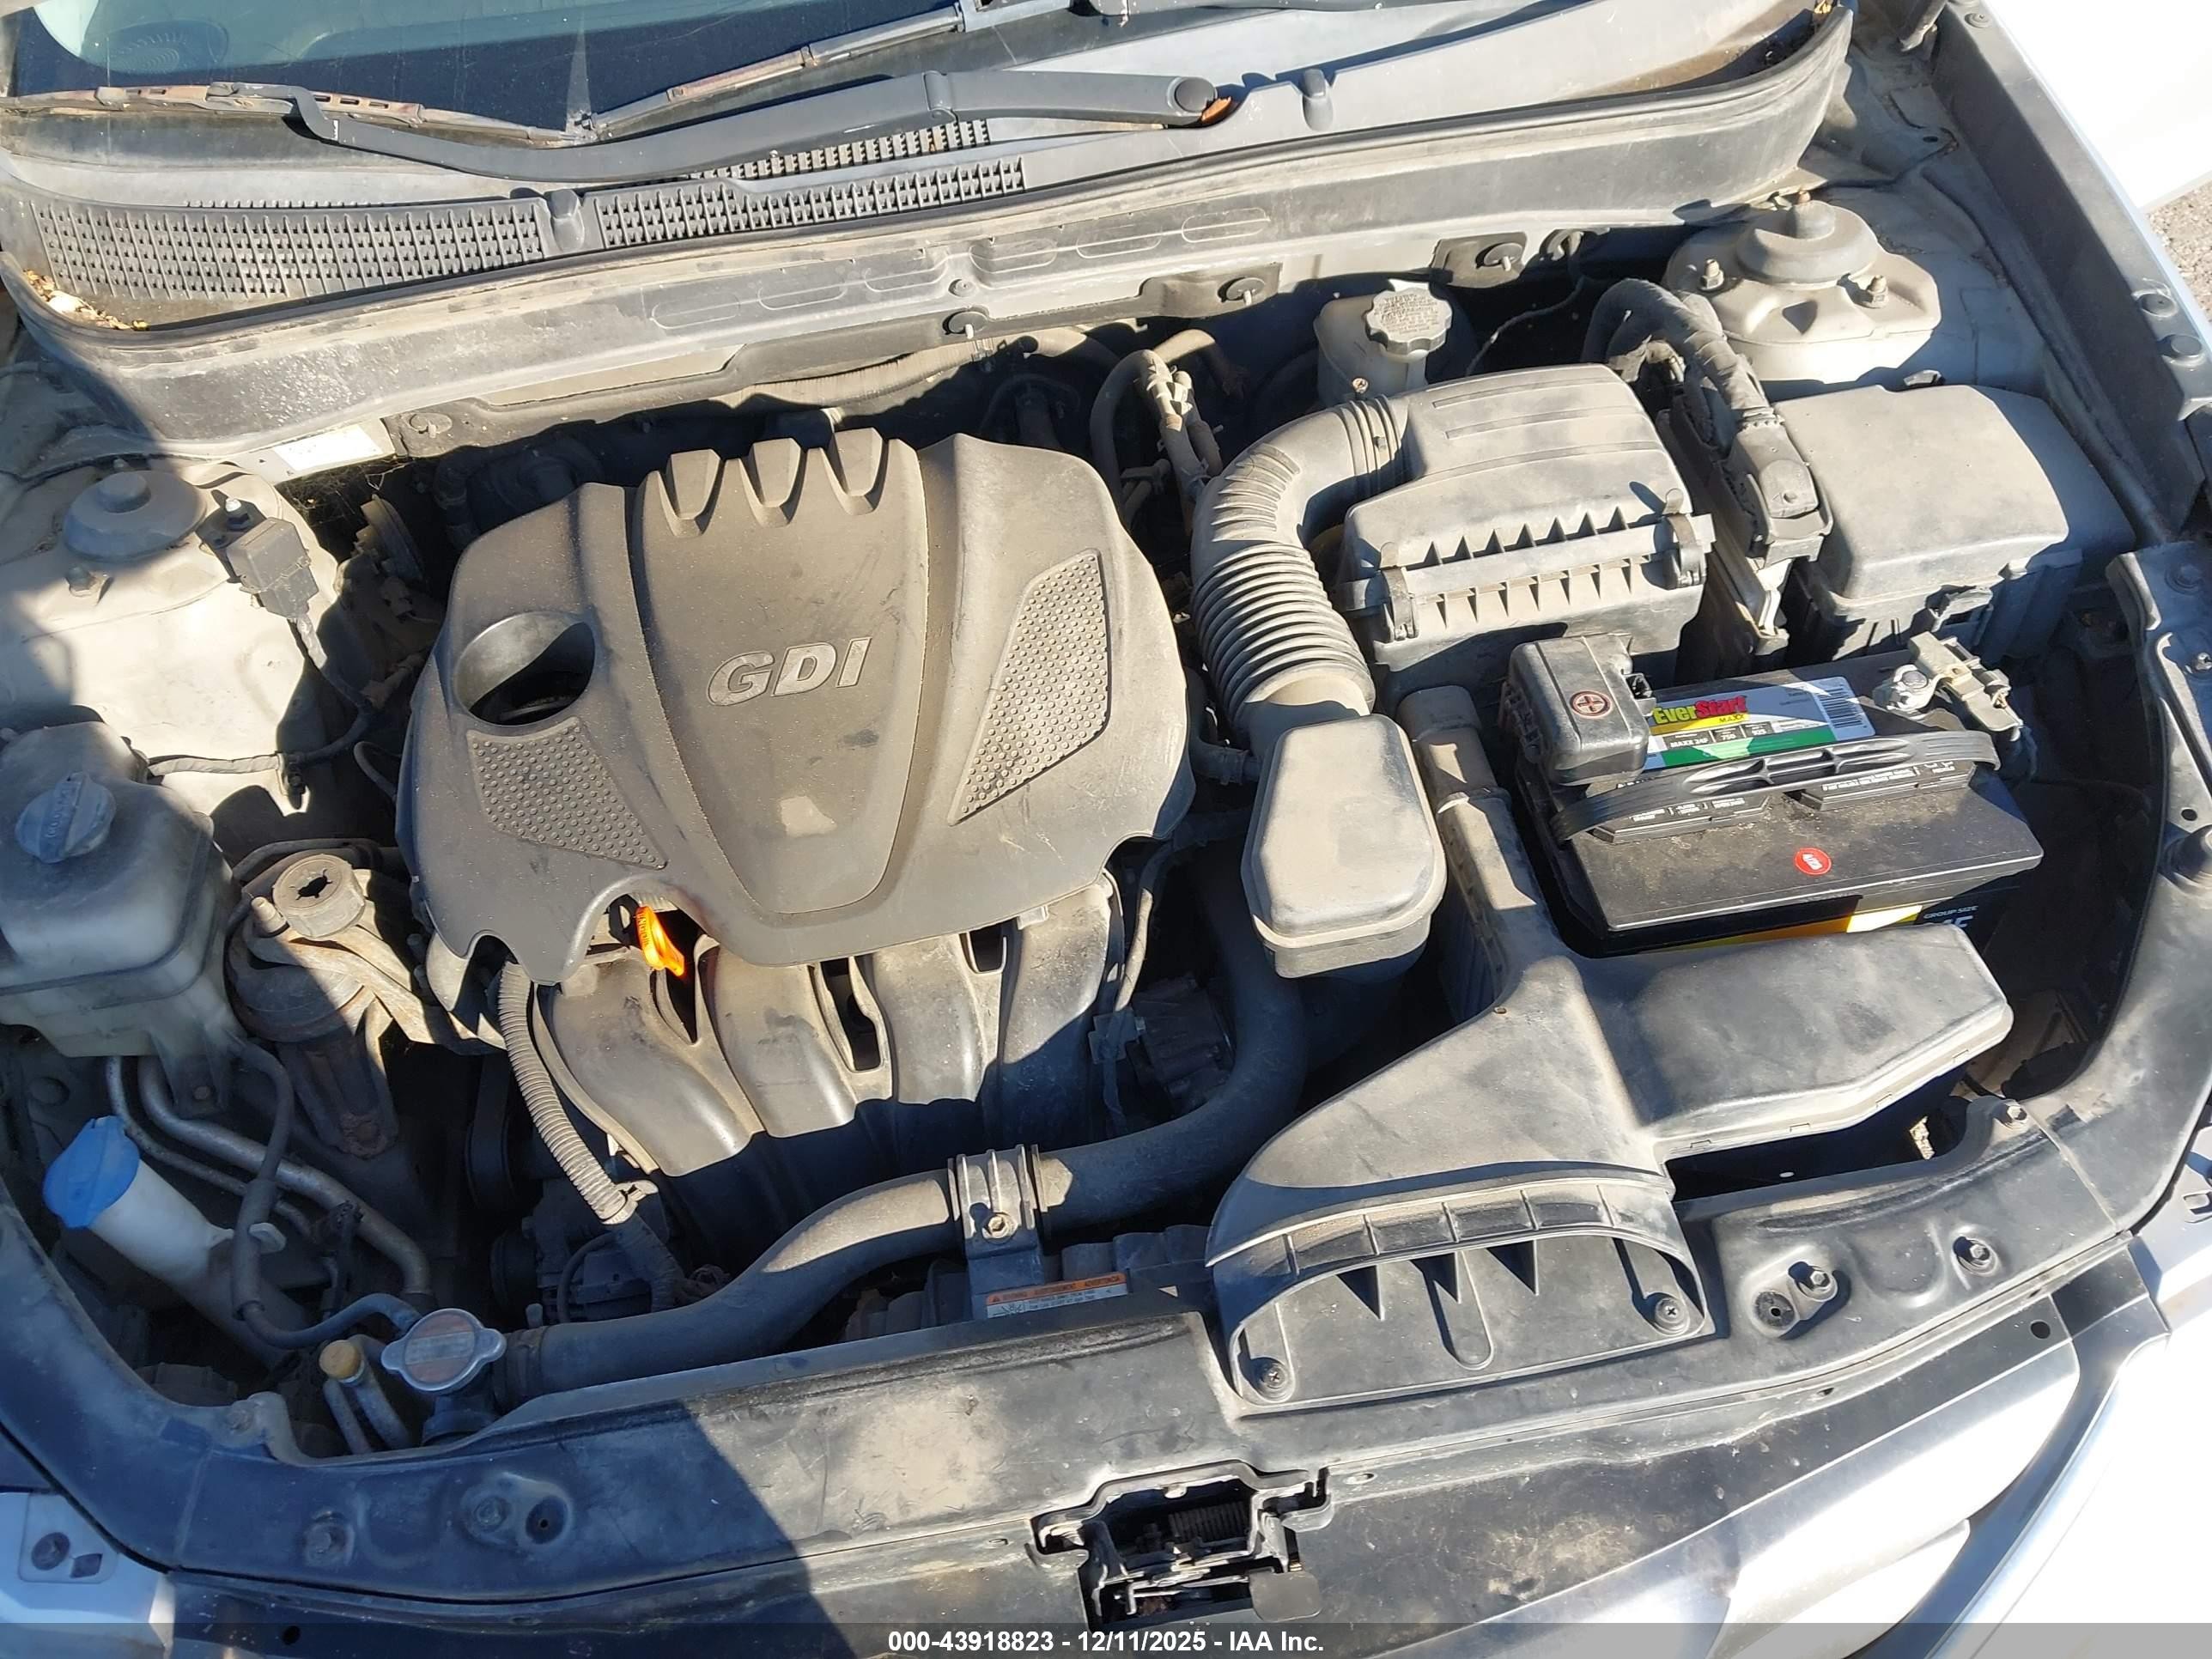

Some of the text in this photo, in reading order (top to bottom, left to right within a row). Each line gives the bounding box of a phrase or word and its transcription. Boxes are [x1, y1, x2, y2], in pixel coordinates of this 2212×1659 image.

[707, 636, 872, 707] GDI
[1654, 696, 1747, 725] EverStart
[1719, 714, 1744, 723] MAXX
[1670, 739, 1694, 749] MAXX
[1923, 905, 1978, 919] GROUP SIZE
